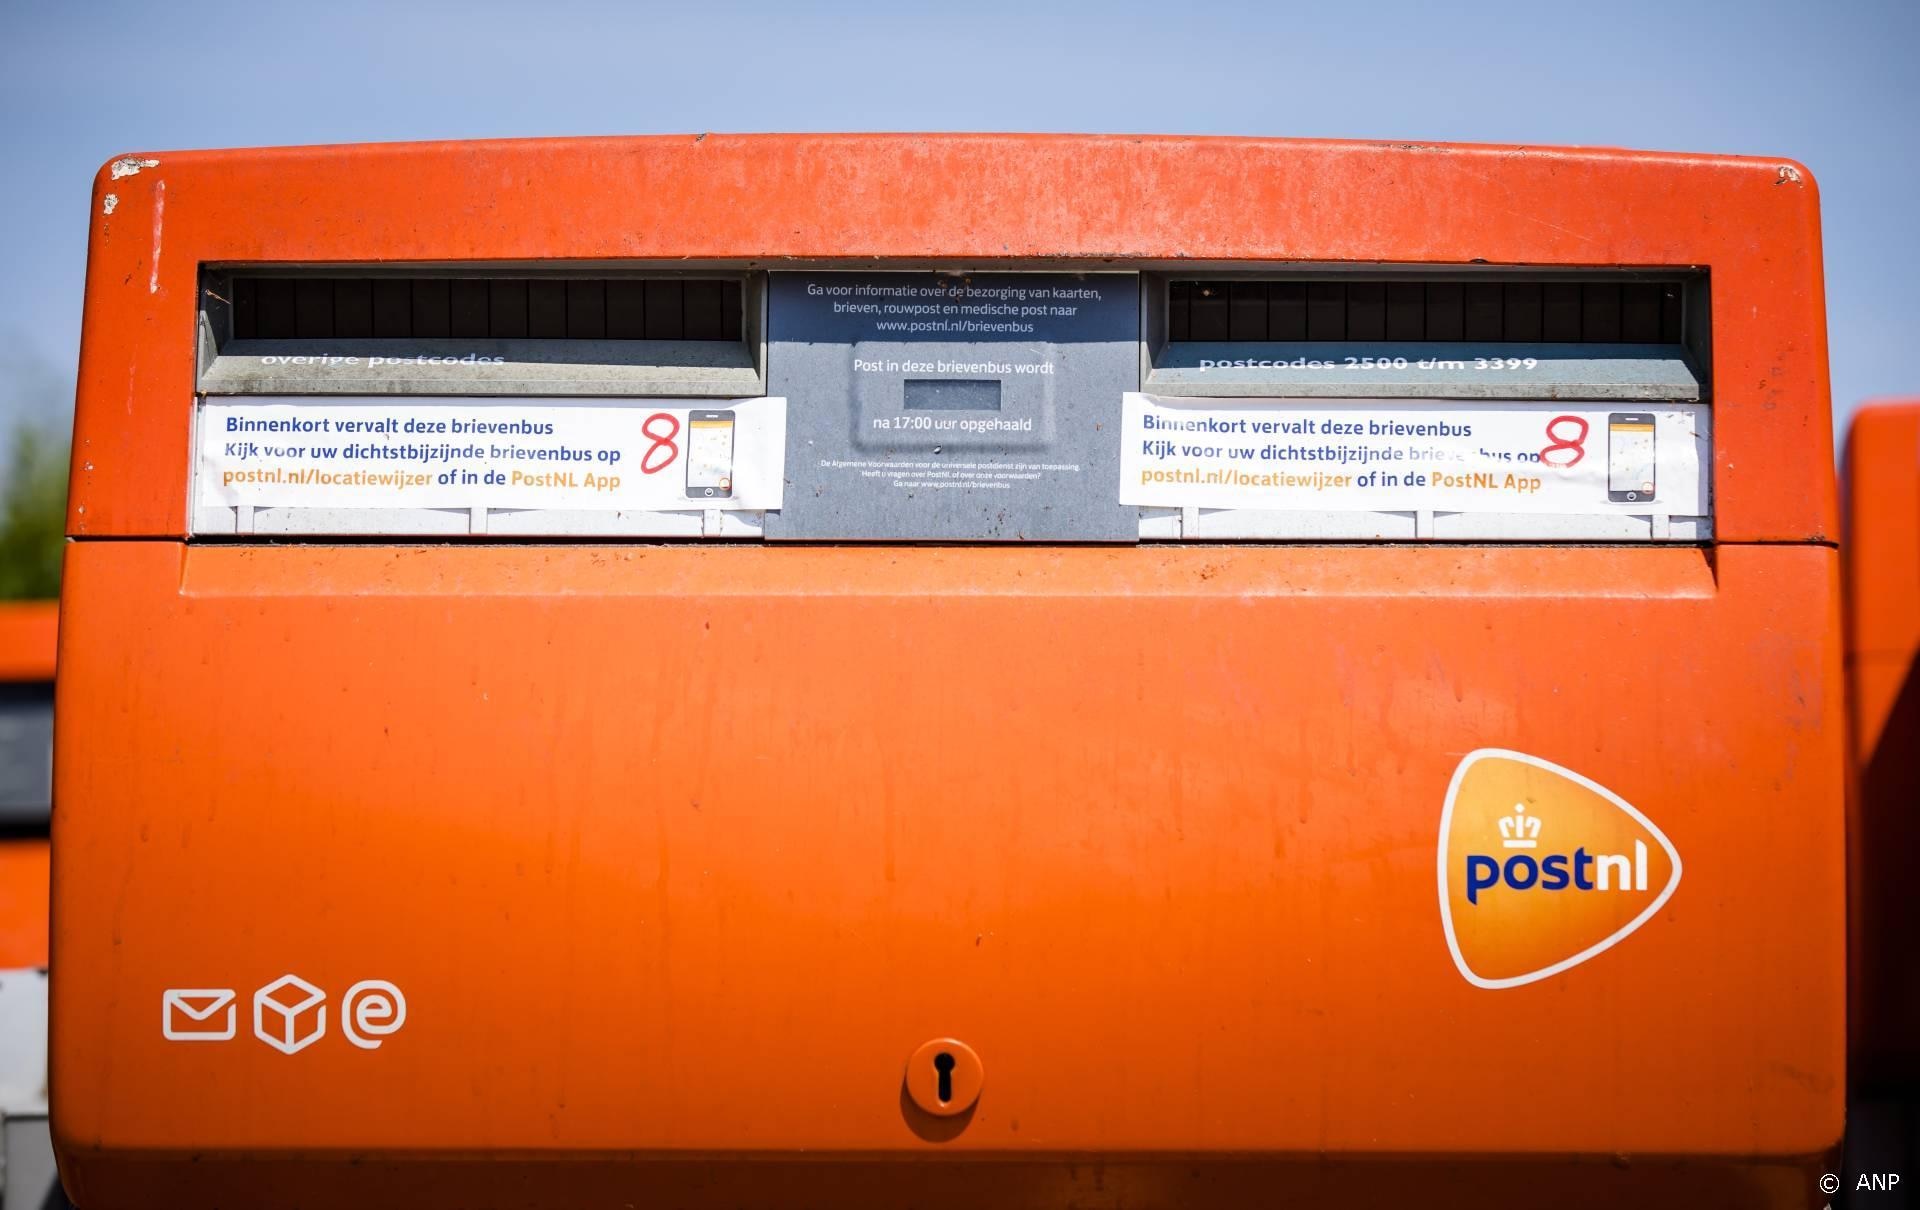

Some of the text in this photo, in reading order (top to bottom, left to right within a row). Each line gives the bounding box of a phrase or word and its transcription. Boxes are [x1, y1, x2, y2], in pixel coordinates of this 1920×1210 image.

[807, 283, 1102, 301] Ga voor informatie over de bezorging van kaarten,
[833, 301, 1078, 318] brieven, rouwpost en medische post naar
[876, 319, 1034, 333] www.postnl.nl/brievenbus
[261, 353, 505, 368] overige postcodes
[854, 359, 1054, 374] Post in deze brievenbus wordt
[1199, 356, 1538, 372] postcodes 2500 t/m 3399
[226, 417, 554, 435] Binnenkort vervalt deze brievenbus
[873, 416, 1033, 433] na 17:00 uur opgehaald
[1143, 414, 1472, 437] Binnenkort vervalt deze brievenbus
[640, 412, 681, 475] 8
[1539, 415, 1590, 468] 8
[225, 442, 621, 465] Kijk voor uw dichtstbijzijnde brievenbus op
[1142, 440, 1177, 460] Kijk
[1182, 445, 1223, 458] voor
[1228, 447, 1255, 459] uw
[1260, 444, 1404, 465] dichtstbijzijnde
[820, 459, 831, 467] De
[832, 459, 866, 469] Algemene
[868, 460, 914, 468] Voorwaarden
[915, 461, 930, 469] voor
[931, 461, 941, 469] de
[941, 461, 977, 469] universele
[977, 462, 1014, 471] postdienst
[1015, 462, 1028, 472] zijn
[861, 470, 881, 478] Heeft
[223, 467, 621, 492] postnl.nl/locatiewijzer of in de PostNL App
[920, 481, 1011, 489] www.postnl.nl/brievenbus
[1141, 467, 1542, 493] postnl.nl/locatiewijzer of in de PostNL App
[1466, 839, 1648, 906] postnl
